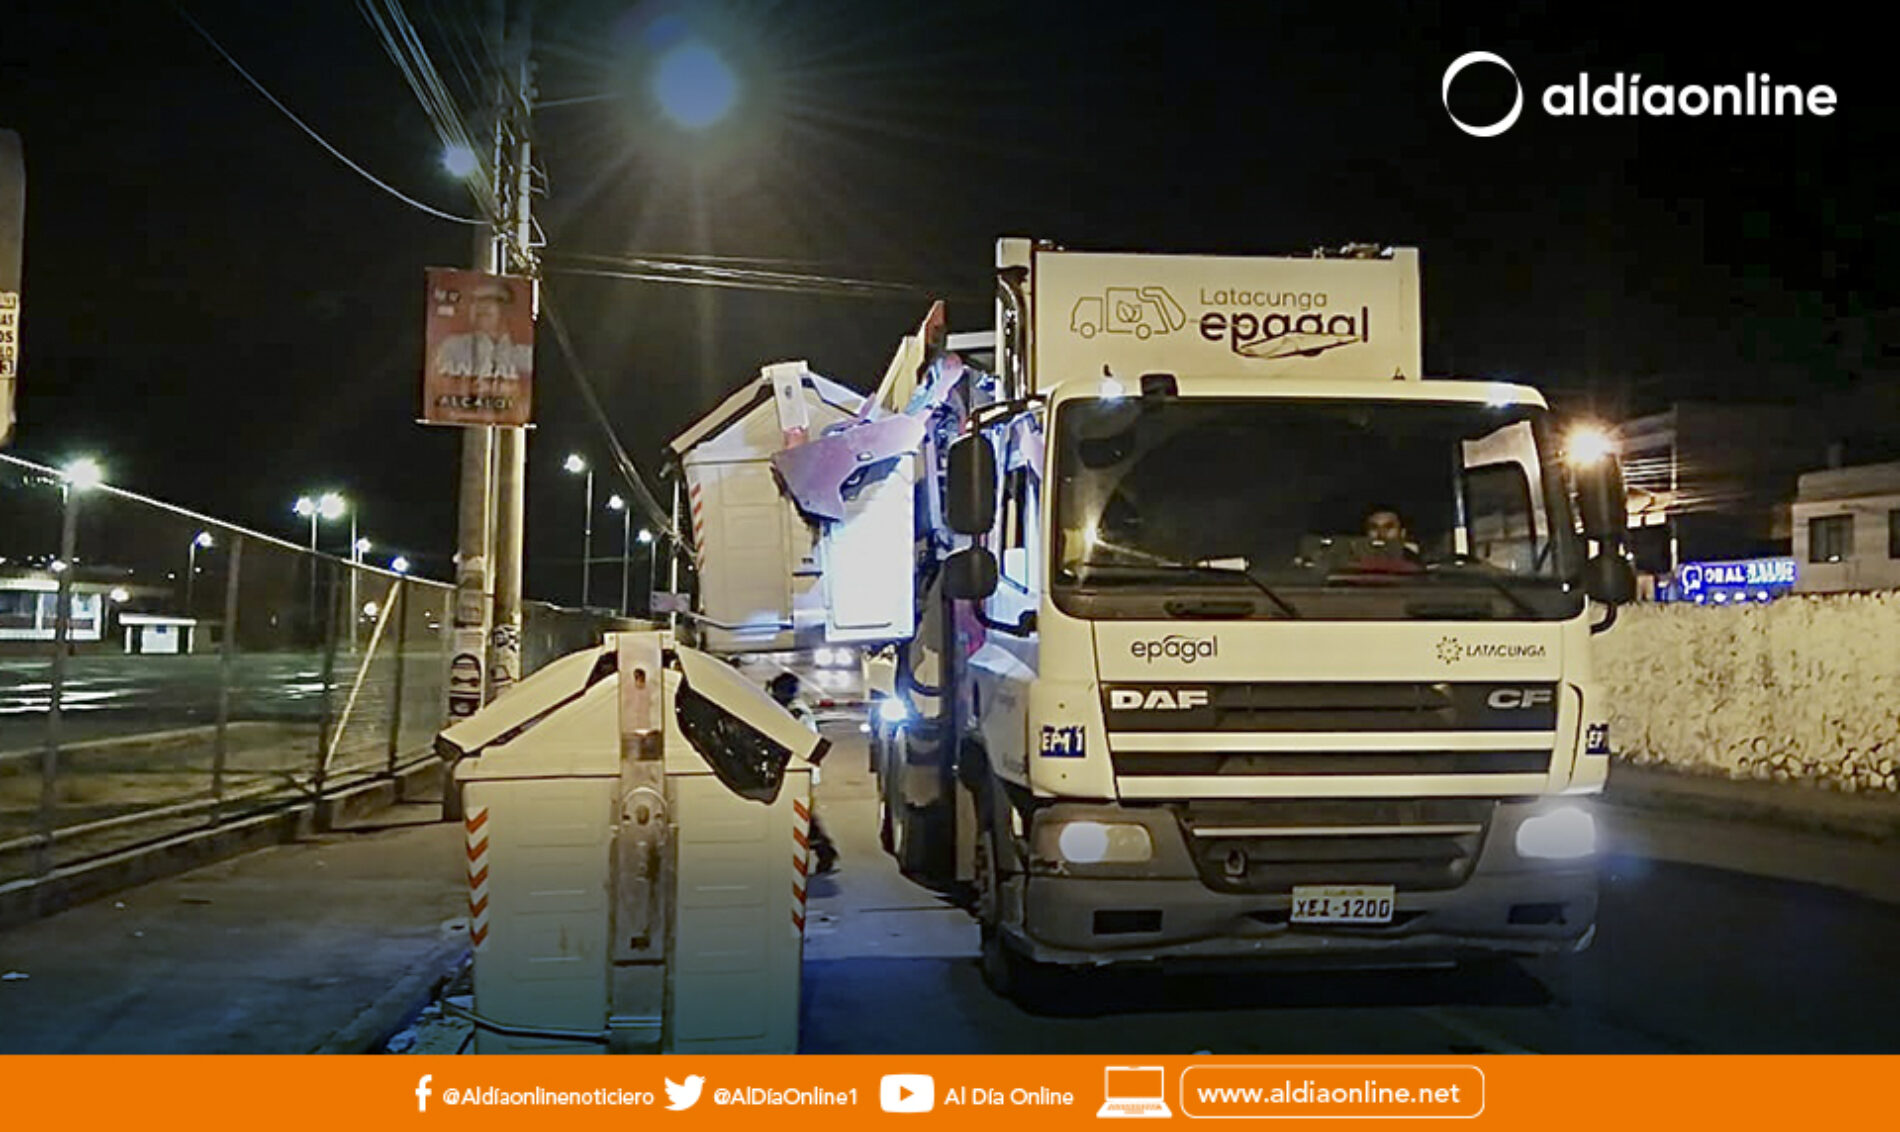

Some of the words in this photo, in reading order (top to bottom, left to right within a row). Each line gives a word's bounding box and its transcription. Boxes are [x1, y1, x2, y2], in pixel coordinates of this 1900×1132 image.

[1200, 287, 1328, 311] Latacunga
[1131, 634, 1218, 664] epagal
[1466, 643, 1546, 657] LATACUNGA
[1110, 690, 1208, 709] DAF
[1487, 689, 1552, 709] CF
